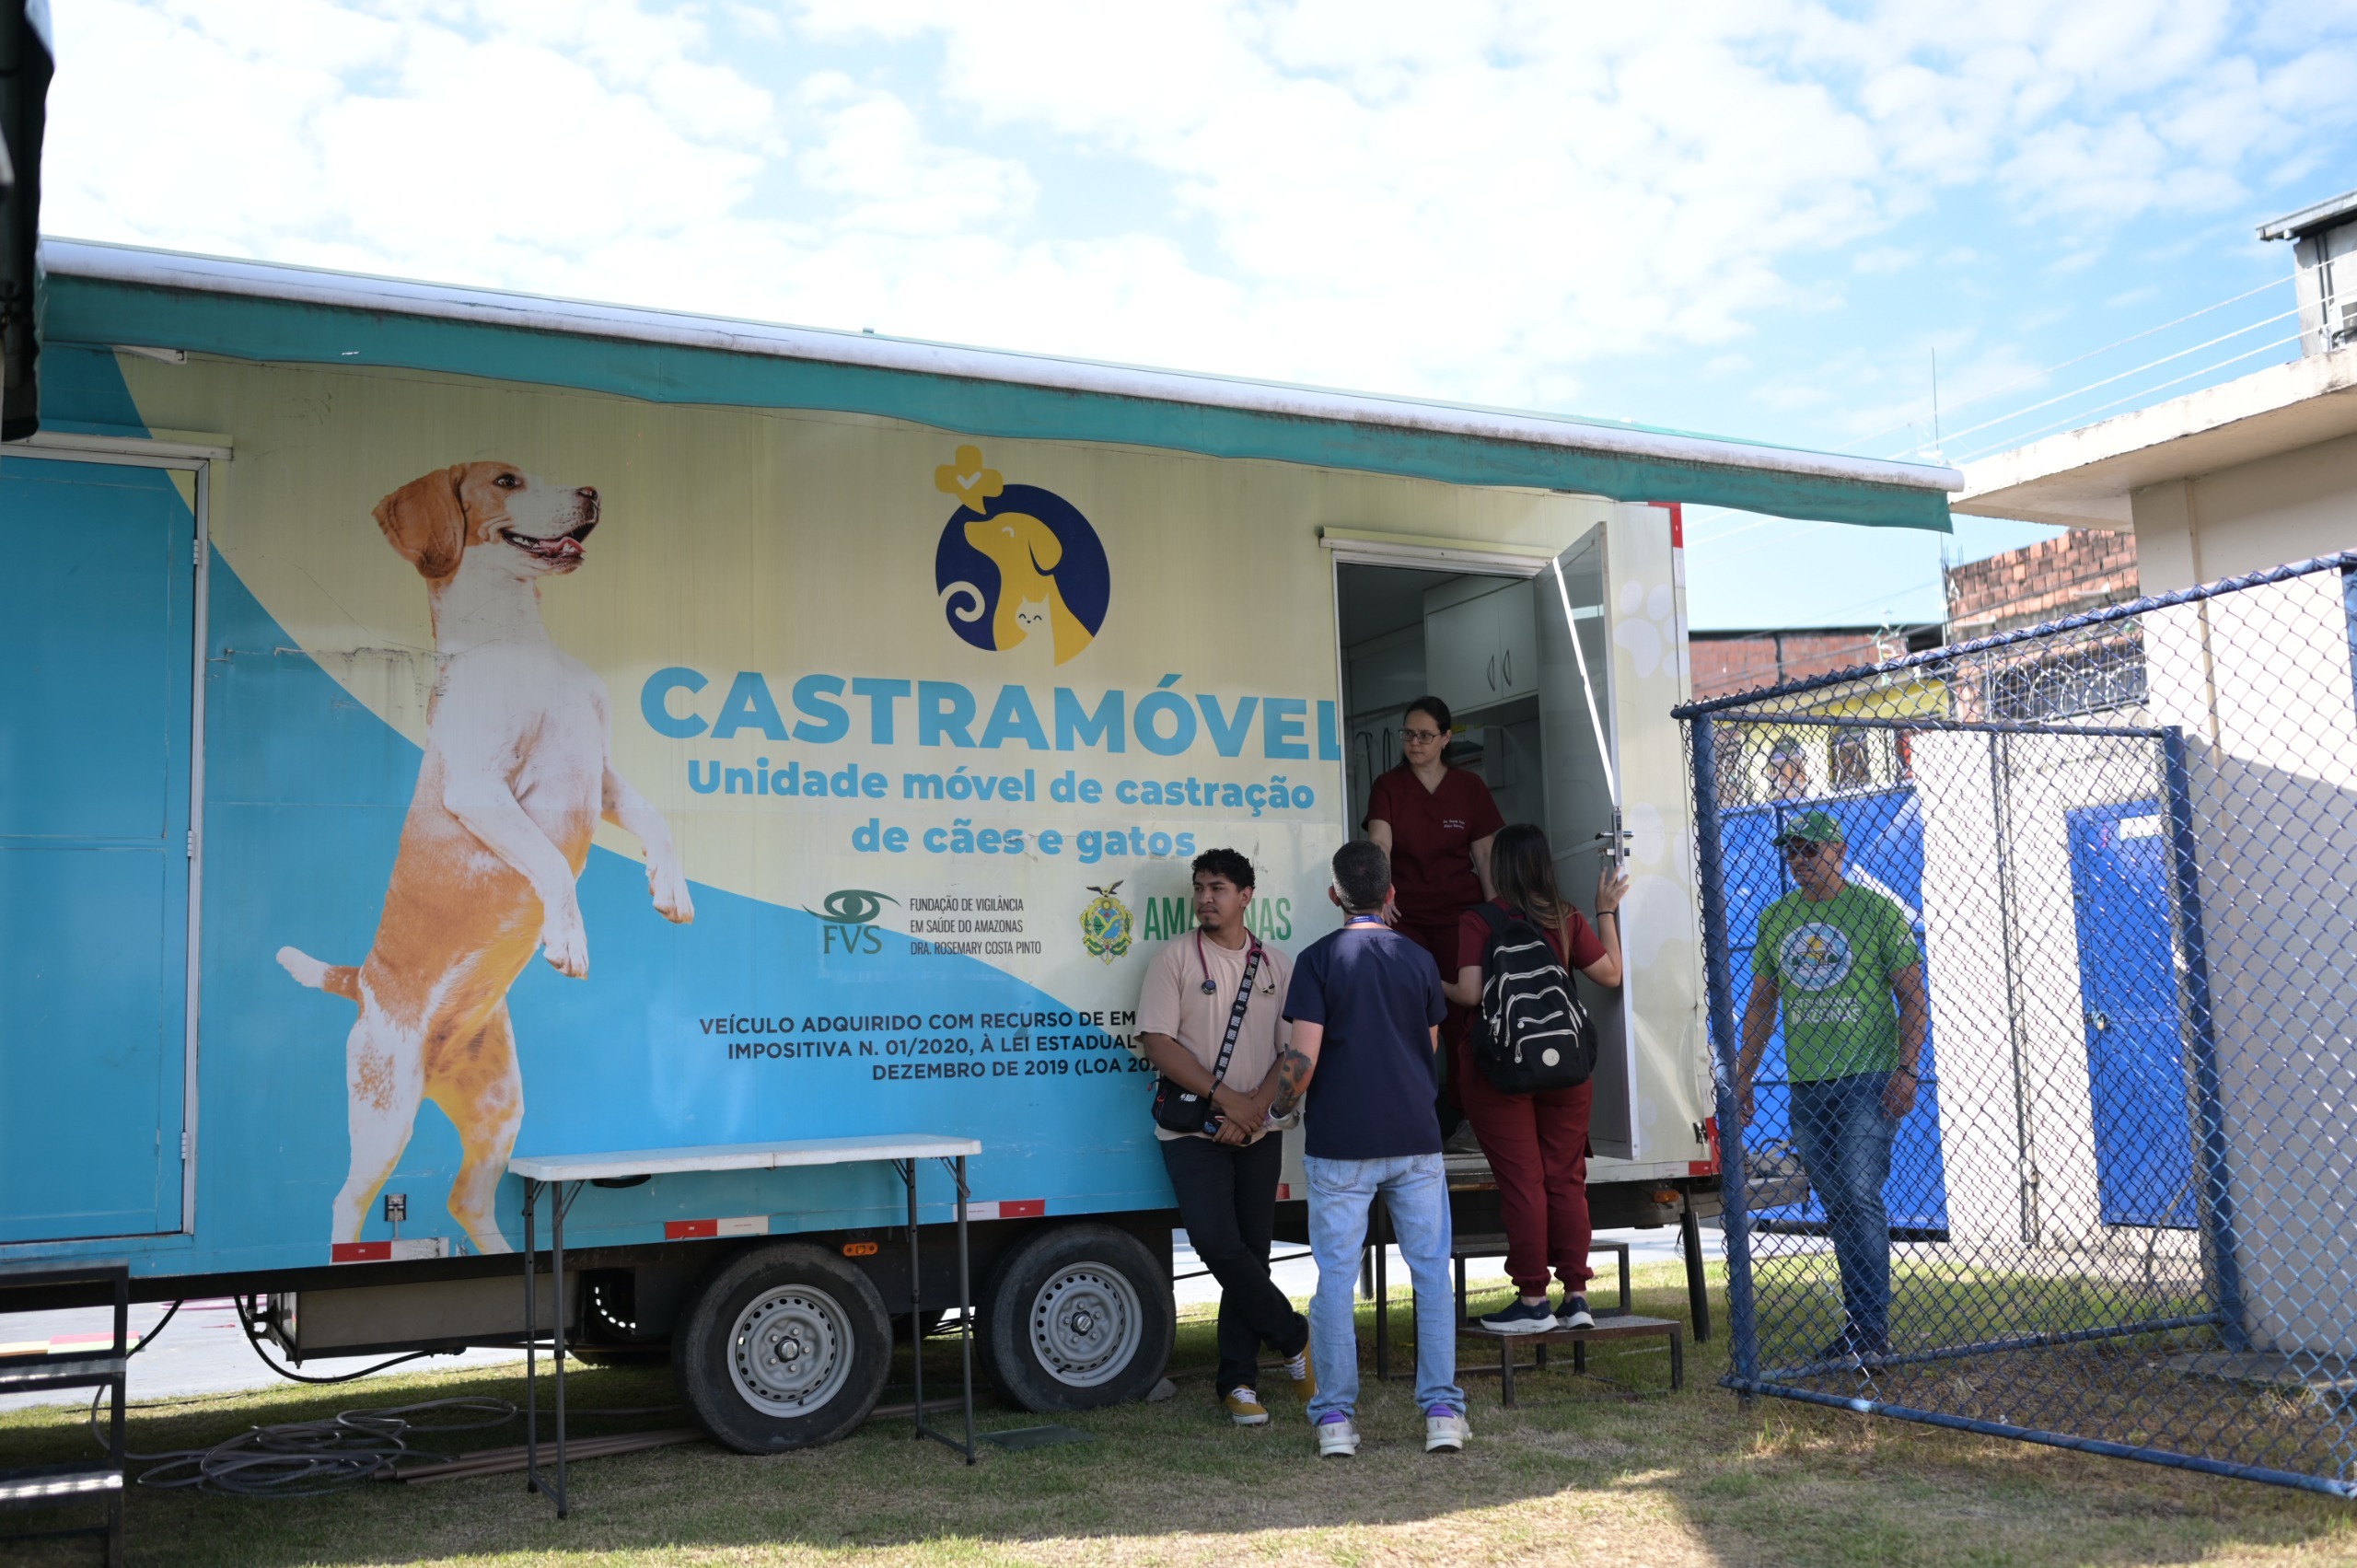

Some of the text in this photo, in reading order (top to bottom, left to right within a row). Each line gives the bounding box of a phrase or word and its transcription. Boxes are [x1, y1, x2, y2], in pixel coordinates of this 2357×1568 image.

[640, 667, 1341, 761] CASTRAMÓVEL
[688, 756, 1315, 818] Unidade móvel de castração
[852, 818, 1196, 864] de cães e gatos
[910, 895, 1024, 913] FUNDAÇÃO DE VIGILÂNCIA
[910, 916, 1024, 934] EM SAÚDE DO AMAZONAS
[823, 924, 882, 955] FVS
[911, 940, 1041, 955] DRA. ROSEMARY COSTA PINTO
[700, 1010, 1136, 1035] VEÍCULO ADQUIRIDO COM RECURSO DE EM
[728, 1033, 1137, 1060] IMPOSITIVA N. 01/2020, À LEI ESTADUAL
[873, 1062, 986, 1081] DEZEMBRO
[993, 1061, 1019, 1077] DE
[1025, 1059, 1069, 1076] 2019
[1074, 1057, 1122, 1076] (LOA
